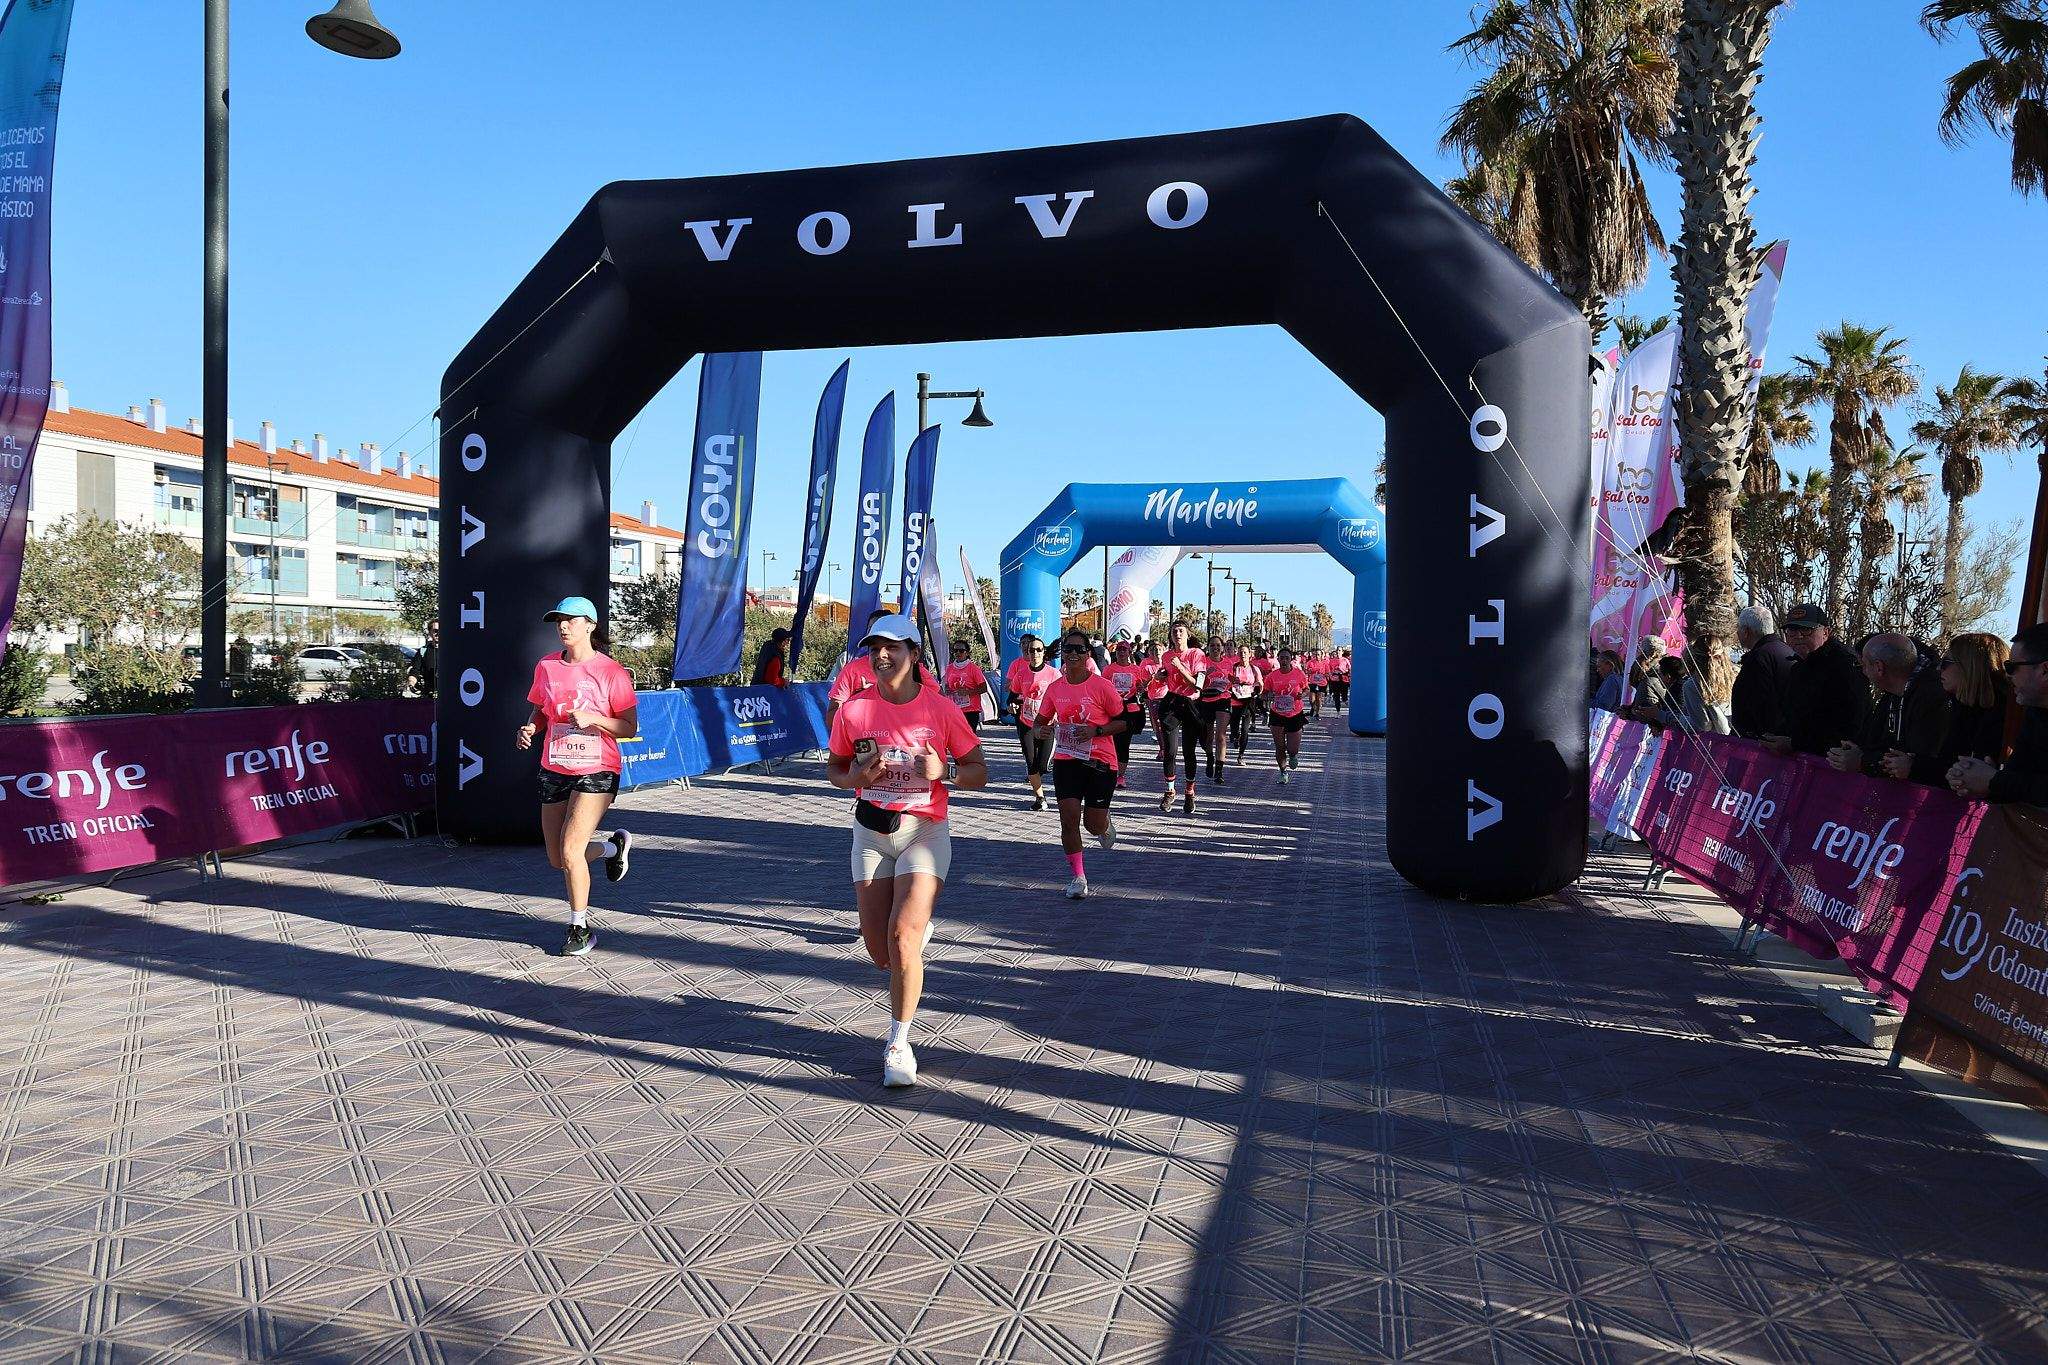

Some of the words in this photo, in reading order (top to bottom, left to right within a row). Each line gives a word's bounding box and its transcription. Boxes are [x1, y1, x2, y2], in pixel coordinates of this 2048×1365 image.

[15, 151, 29, 168] EL
[13, 175, 44, 192] MAMA
[0, 195, 34, 218] ÁSICO
[684, 181, 1209, 262] VOLVO
[1616, 414, 1637, 427] Sal
[3, 434, 22, 451] AL
[697, 433, 735, 559] GOYA
[1144, 487, 1258, 538] Marlene
[1603, 491, 1624, 503] Sal
[861, 492, 880, 585] GOYA
[1341, 526, 1377, 542] Marlene
[459, 432, 487, 791] VOLVO
[1007, 617, 1042, 635] Marlene
[1467, 404, 1508, 841] VOLVO
[733, 696, 771, 722] GOYA
[225, 729, 330, 782] renfe
[566, 743, 586, 751] 016
[886, 770, 911, 782] 016
[250, 794, 284, 813] TREN
[287, 783, 339, 807] OFICIAL
[1711, 779, 1776, 838] renfe
[23, 820, 78, 846] TREN
[83, 813, 155, 839] OFICIAL
[1702, 836, 1722, 859] TREN
[1720, 845, 1747, 873] OFICIAL
[1811, 817, 1905, 890] renfe
[1800, 884, 1827, 914] TREN
[1824, 897, 1865, 933] OFICIAL
[1973, 992, 2012, 1025] Clínica
